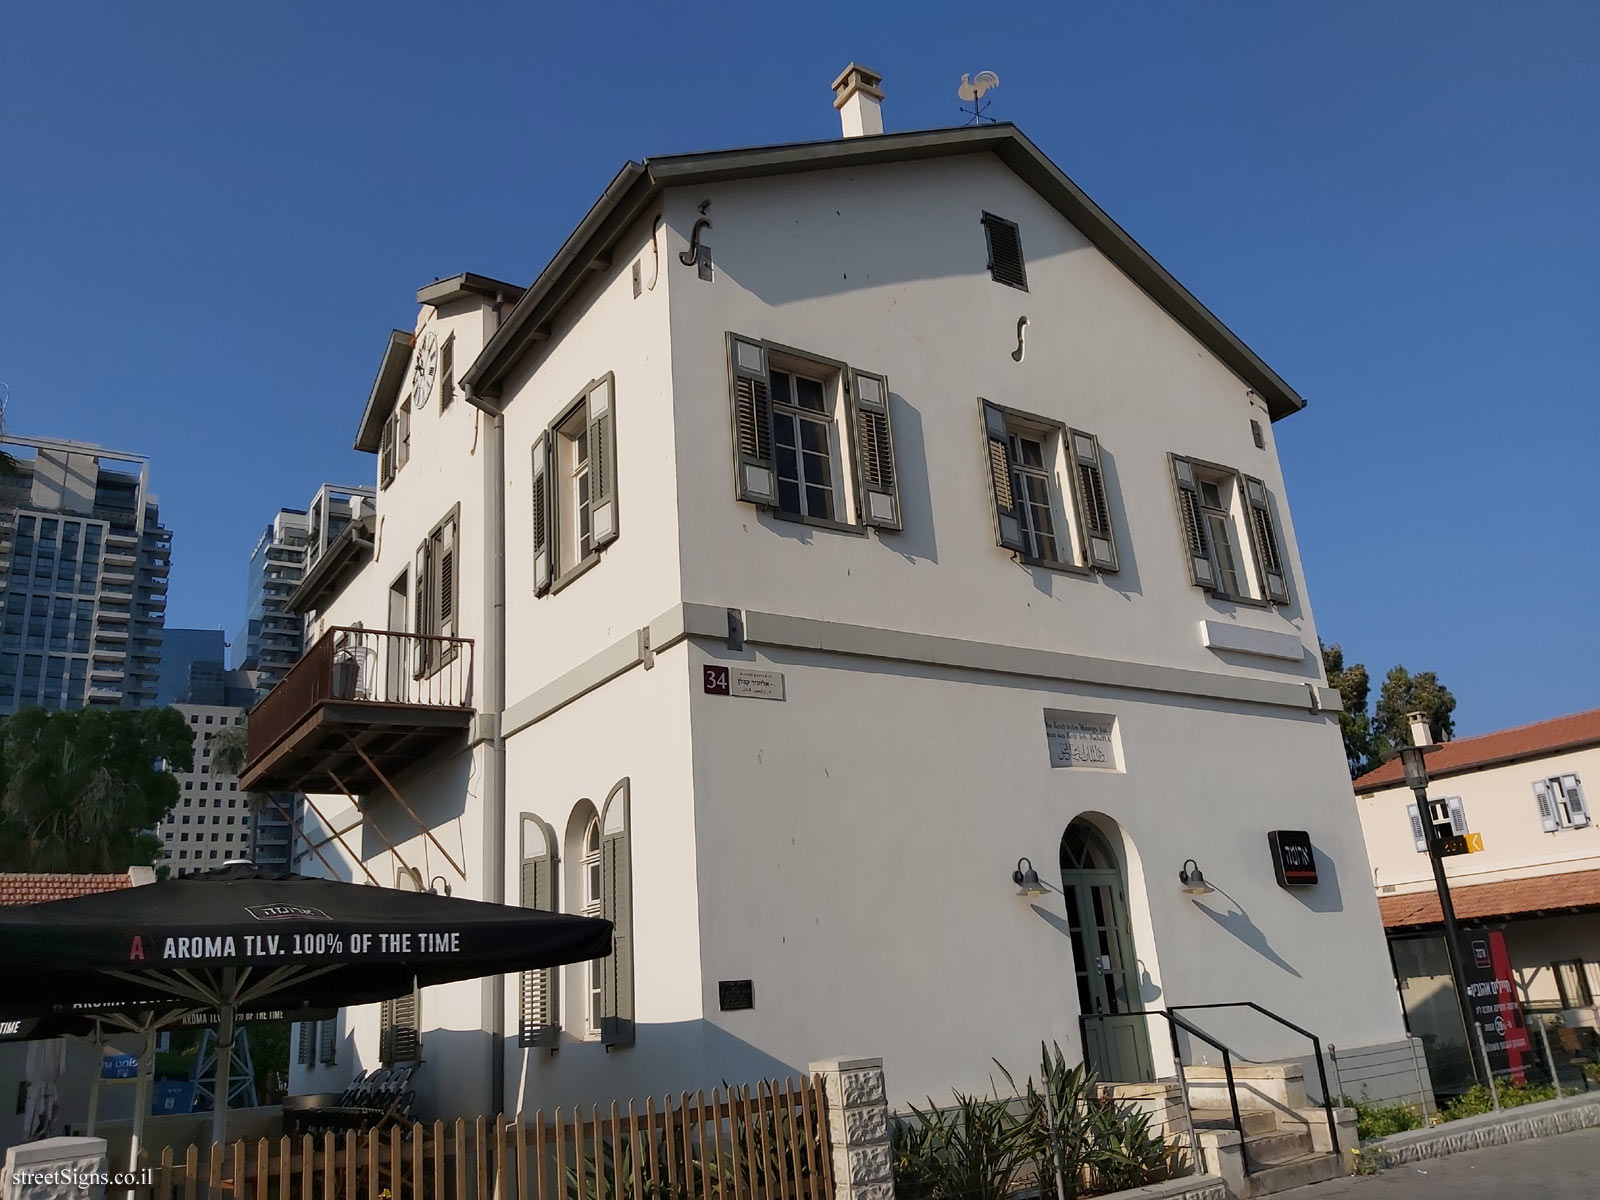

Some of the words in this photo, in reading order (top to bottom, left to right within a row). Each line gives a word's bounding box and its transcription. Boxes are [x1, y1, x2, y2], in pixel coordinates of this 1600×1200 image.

[706, 670, 728, 690] 34
[1284, 845, 1310, 866] ארומה
[262, 906, 314, 917] ארומה
[163, 936, 237, 960] AROMA
[243, 934, 285, 957] TLV.
[292, 932, 344, 955] 100%
[350, 933, 373, 954] OF
[379, 933, 412, 953] THE
[418, 932, 461, 953] TIME
[0, 1020, 21, 1035] TIME
